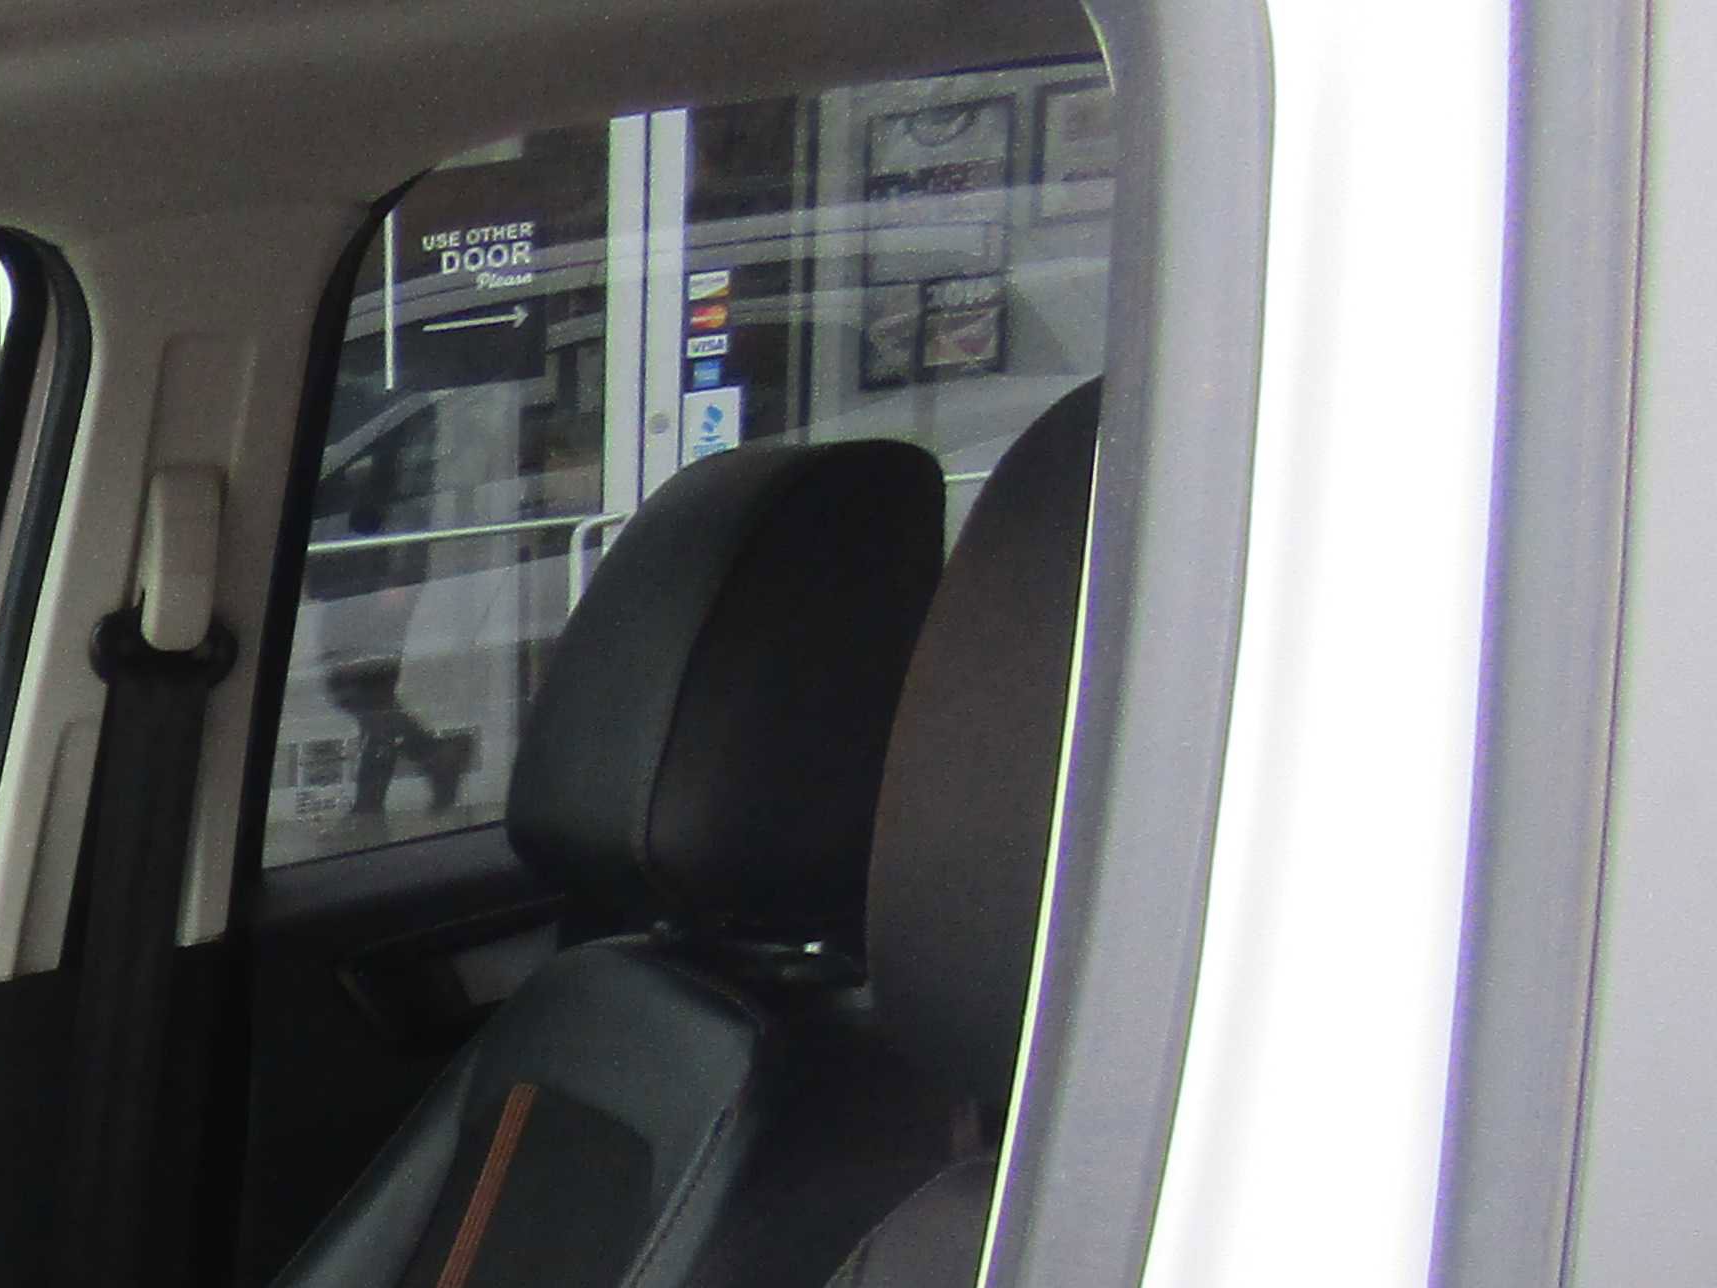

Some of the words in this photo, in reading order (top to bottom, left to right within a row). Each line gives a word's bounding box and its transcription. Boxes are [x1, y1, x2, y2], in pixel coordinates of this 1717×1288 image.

[422, 230, 461, 251] USE
[466, 221, 535, 245] OTHER
[441, 241, 532, 275] DOOR
